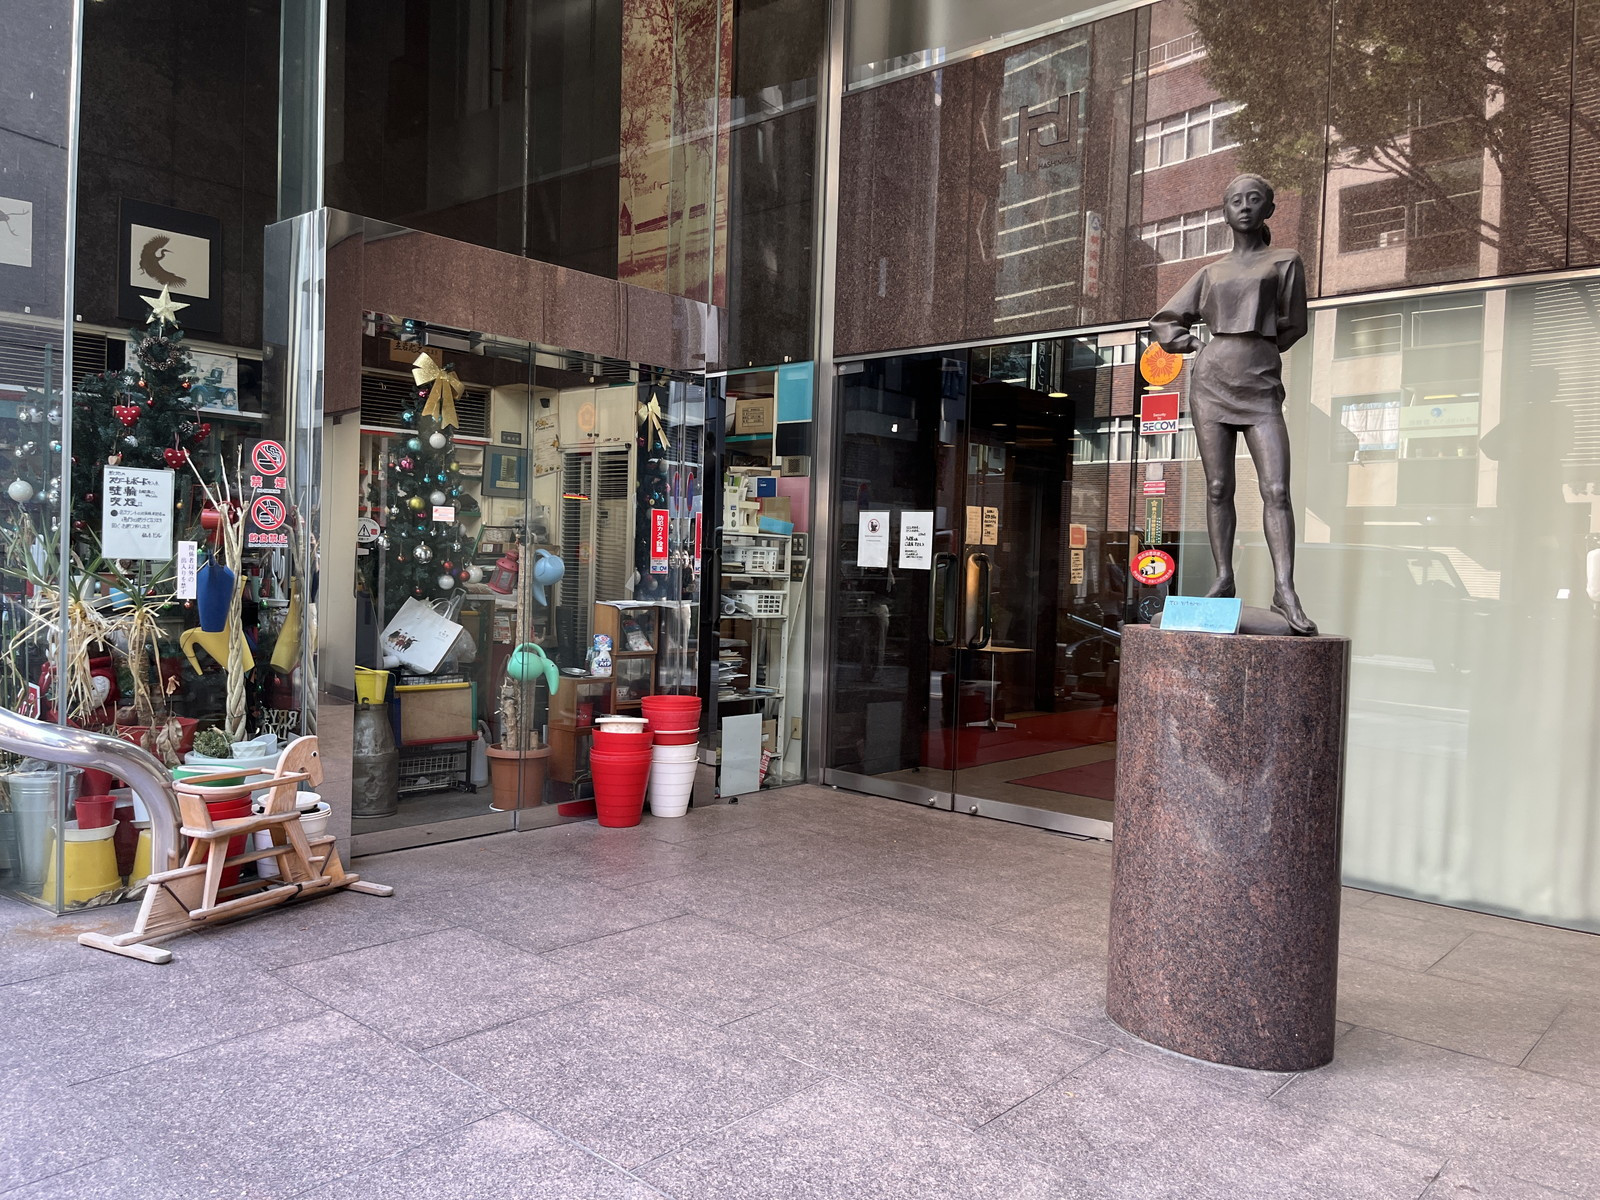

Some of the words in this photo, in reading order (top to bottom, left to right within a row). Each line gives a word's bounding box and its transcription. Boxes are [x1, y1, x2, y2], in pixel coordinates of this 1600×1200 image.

[1142, 421, 1176, 431] SECOM
[250, 475, 287, 489] 禁煙
[248, 533, 288, 543] 飲食禁止
[656, 515, 664, 552] 防犯カメラ設置
